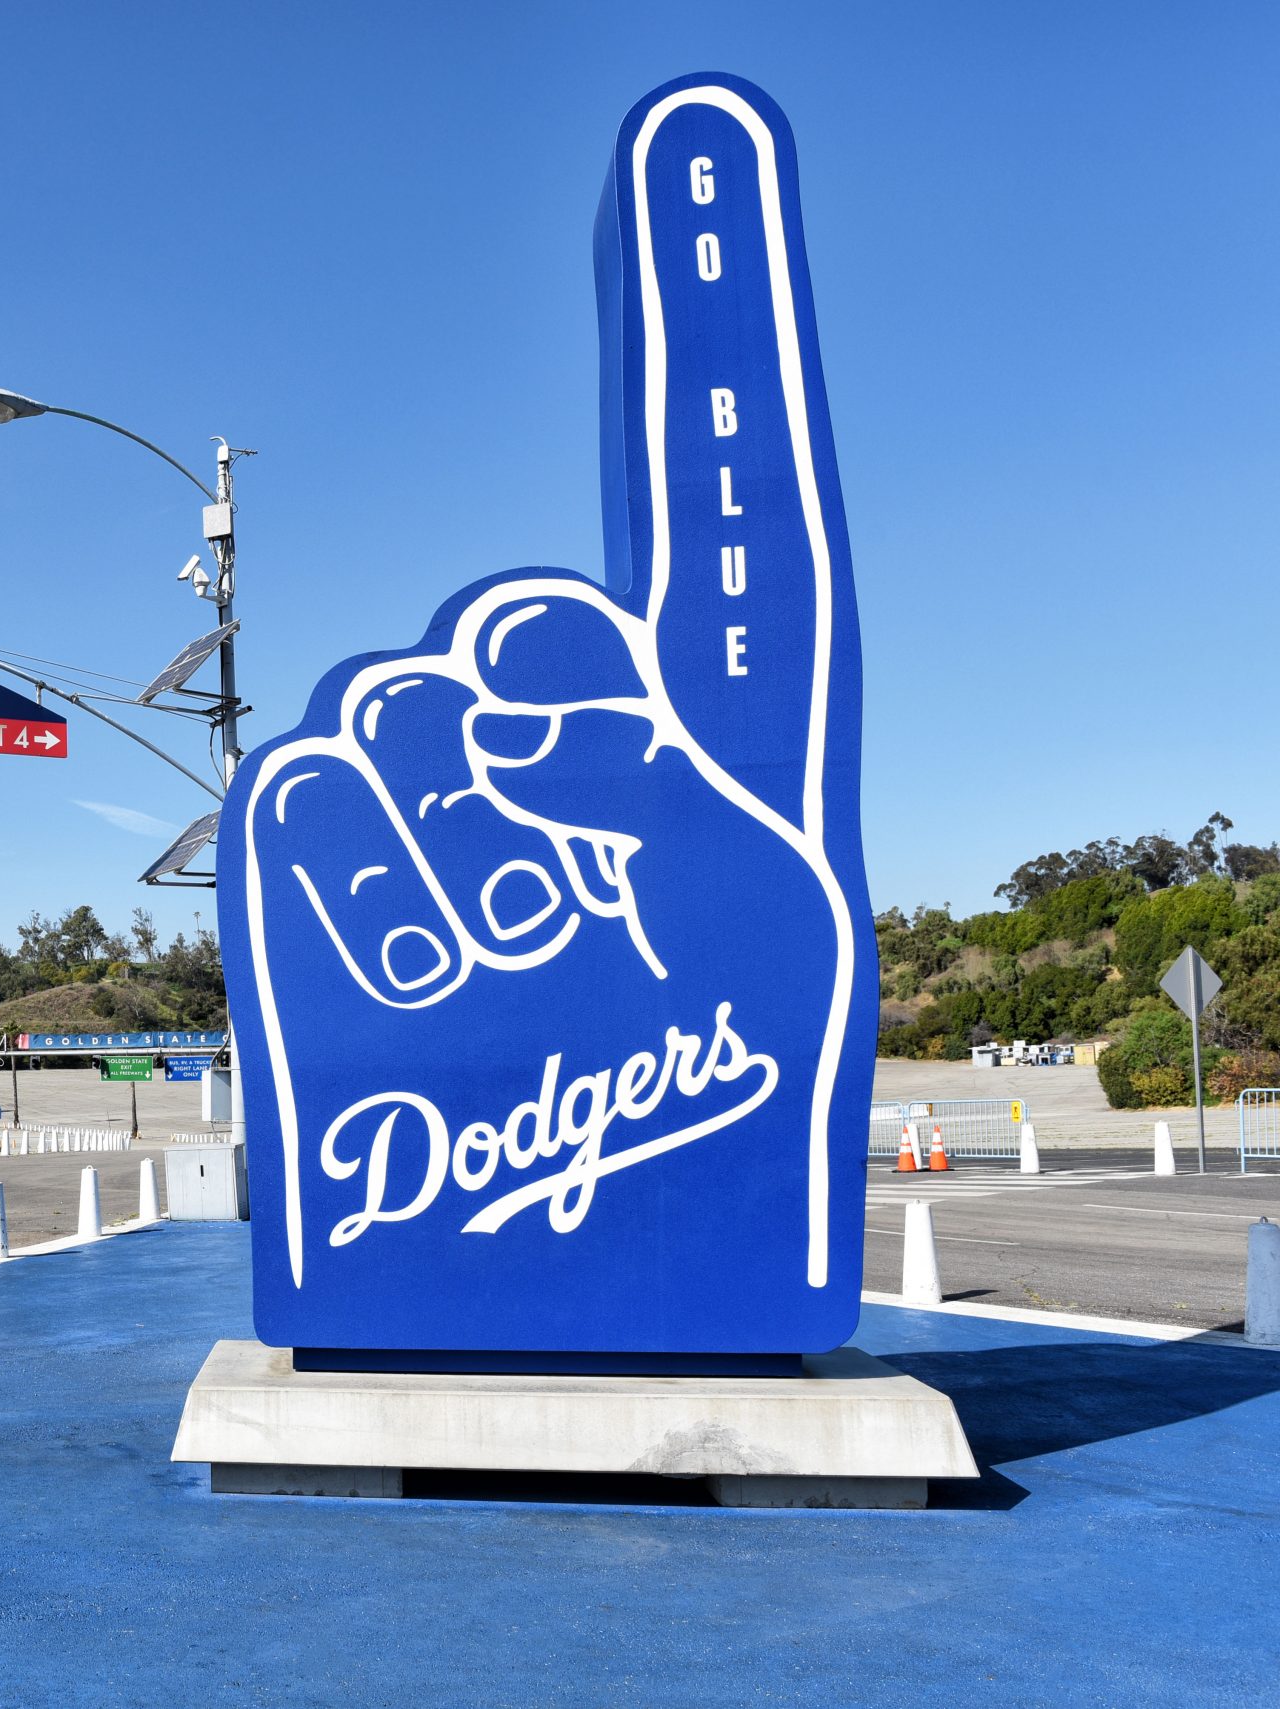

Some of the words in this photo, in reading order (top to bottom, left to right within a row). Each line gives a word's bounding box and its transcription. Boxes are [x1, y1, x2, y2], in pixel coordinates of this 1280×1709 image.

[689, 156, 722, 282] GO
[710, 387, 748, 677] BLUE
[13, 726, 30, 749] 4
[45, 1036, 129, 1046] GOLDEN
[145, 1035, 206, 1044] STATE
[320, 1001, 779, 1248] Dodgers
